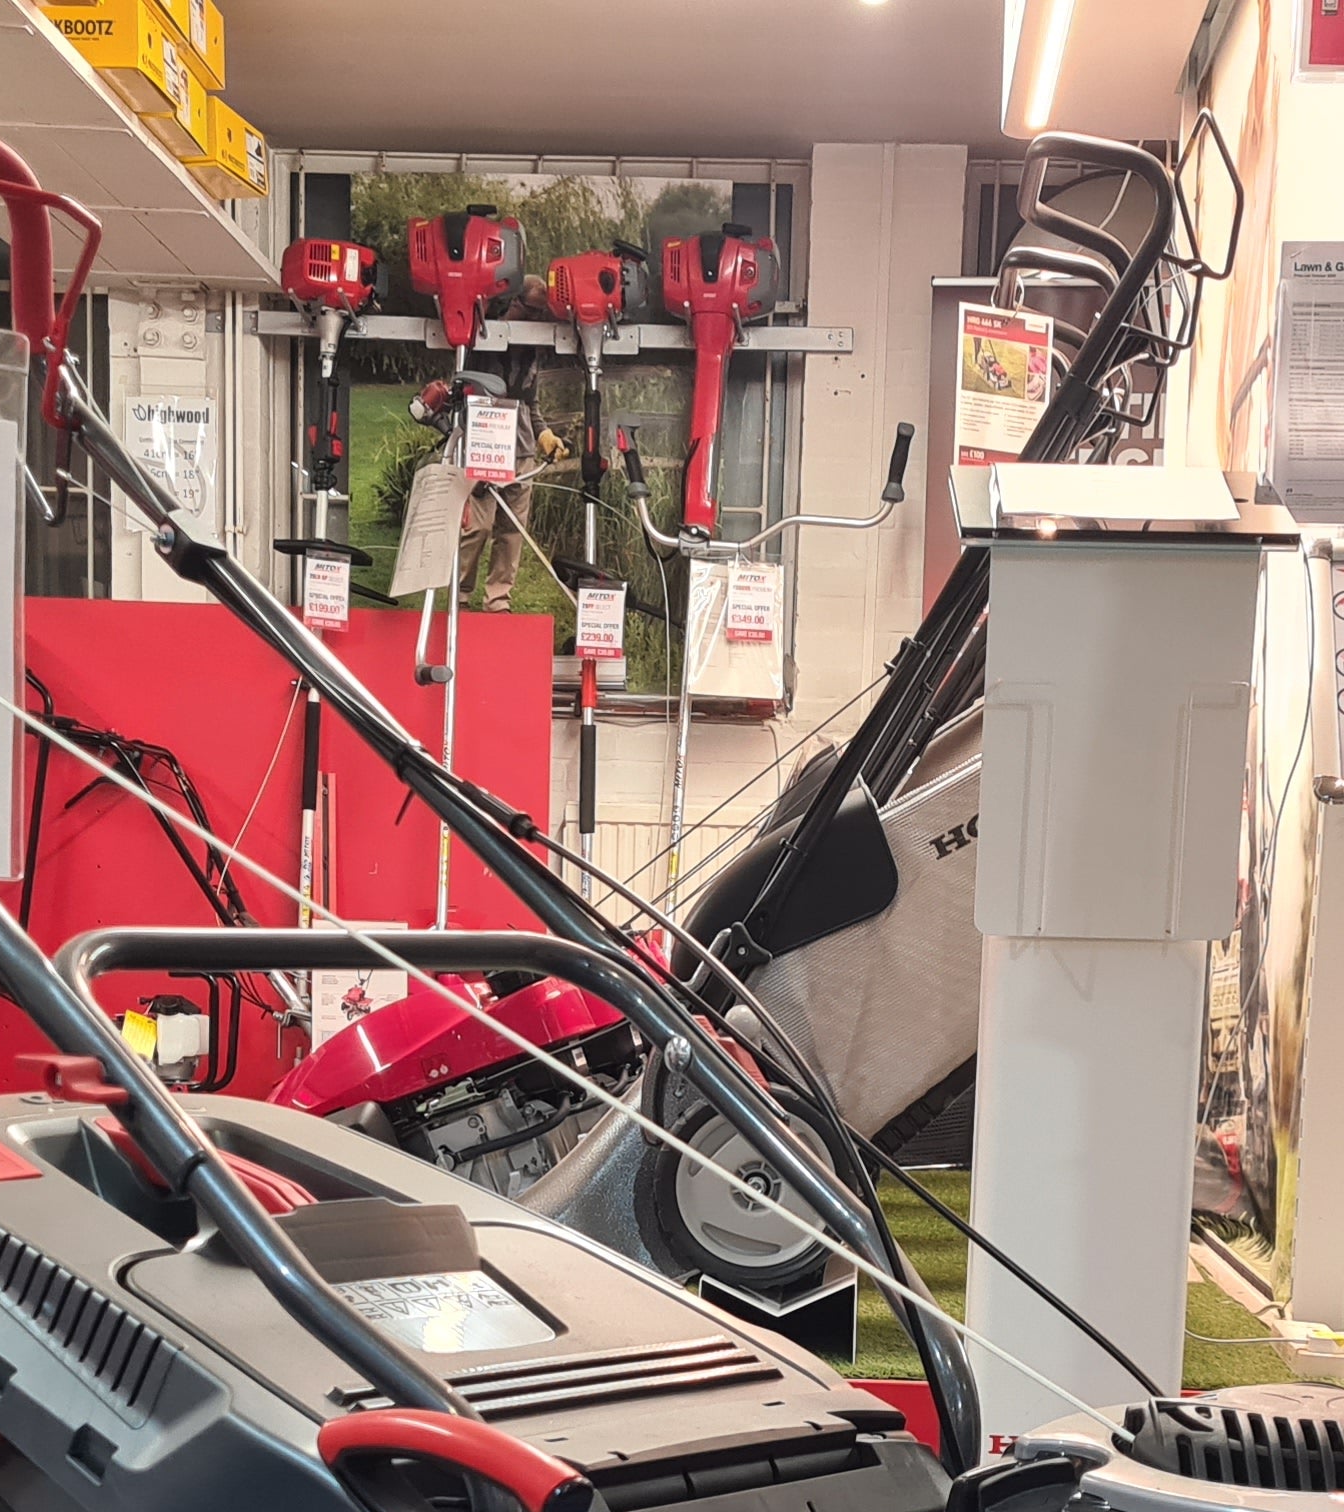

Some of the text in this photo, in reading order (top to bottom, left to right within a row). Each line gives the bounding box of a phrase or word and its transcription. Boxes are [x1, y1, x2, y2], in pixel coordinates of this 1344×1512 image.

[1293, 261, 1323, 273] Lawn
[1324, 261, 1333, 273] &
[471, 441, 493, 450] SPECIAL
[470, 452, 506, 464] £319.00
[969, 449, 985, 460] £100
